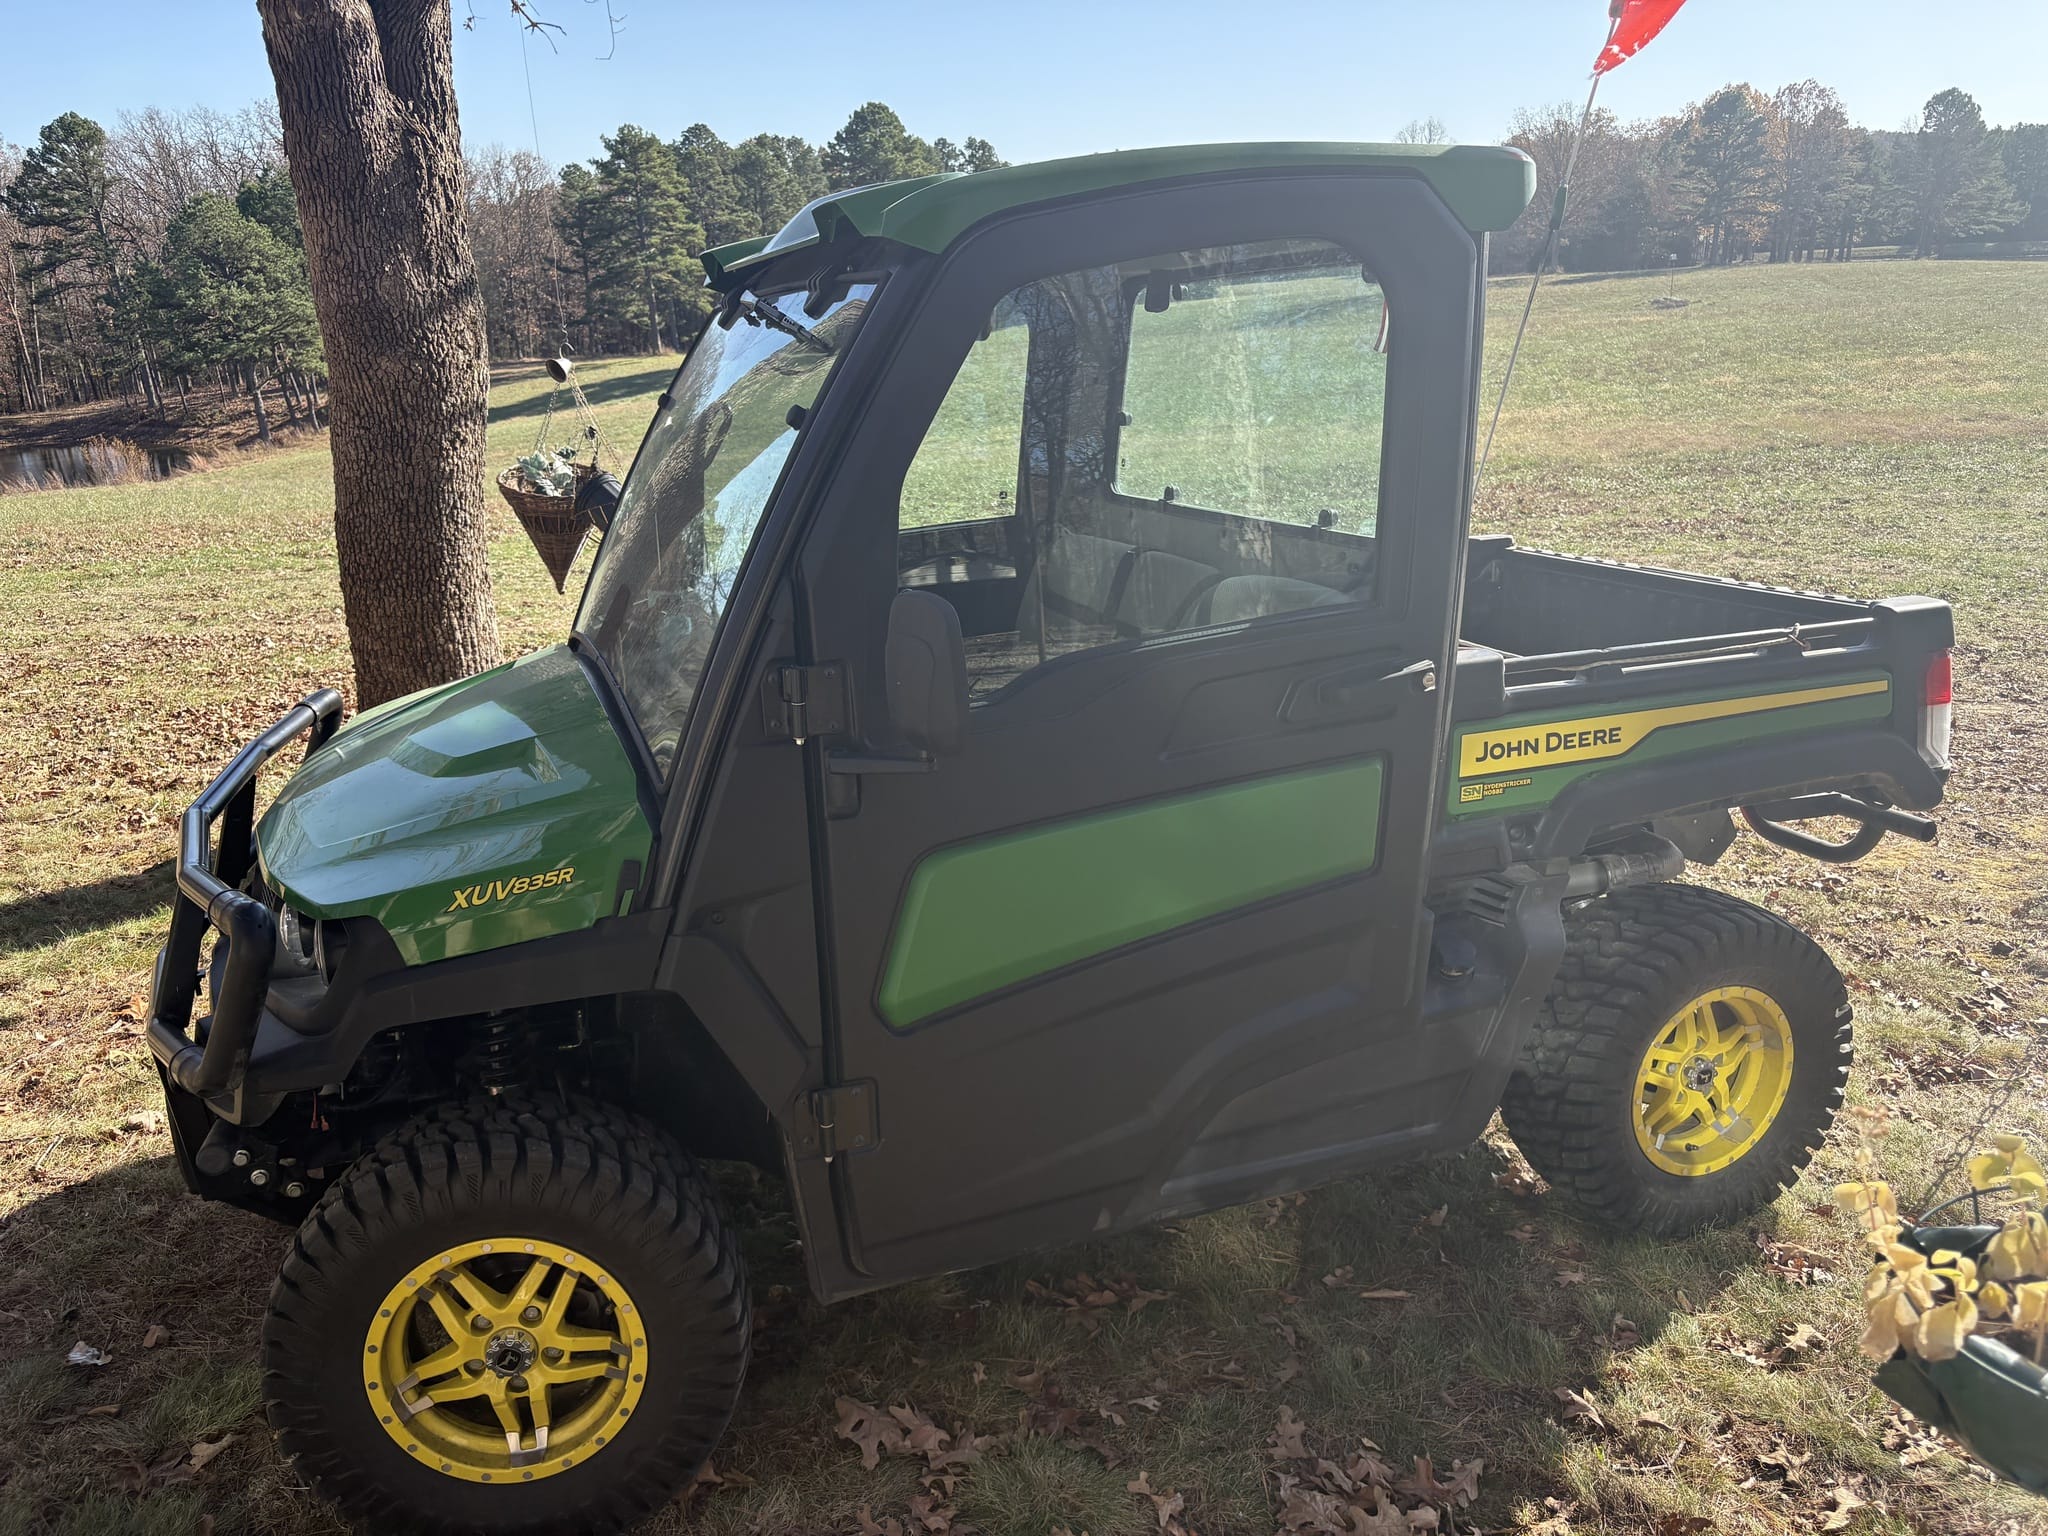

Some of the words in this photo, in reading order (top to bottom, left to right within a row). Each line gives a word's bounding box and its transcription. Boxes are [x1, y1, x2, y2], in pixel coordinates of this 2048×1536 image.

[1475, 738, 1540, 762] JOHN
[1545, 727, 1622, 753] DEERE
[1462, 786, 1481, 797] SN
[447, 867, 576, 913] XUV835R
